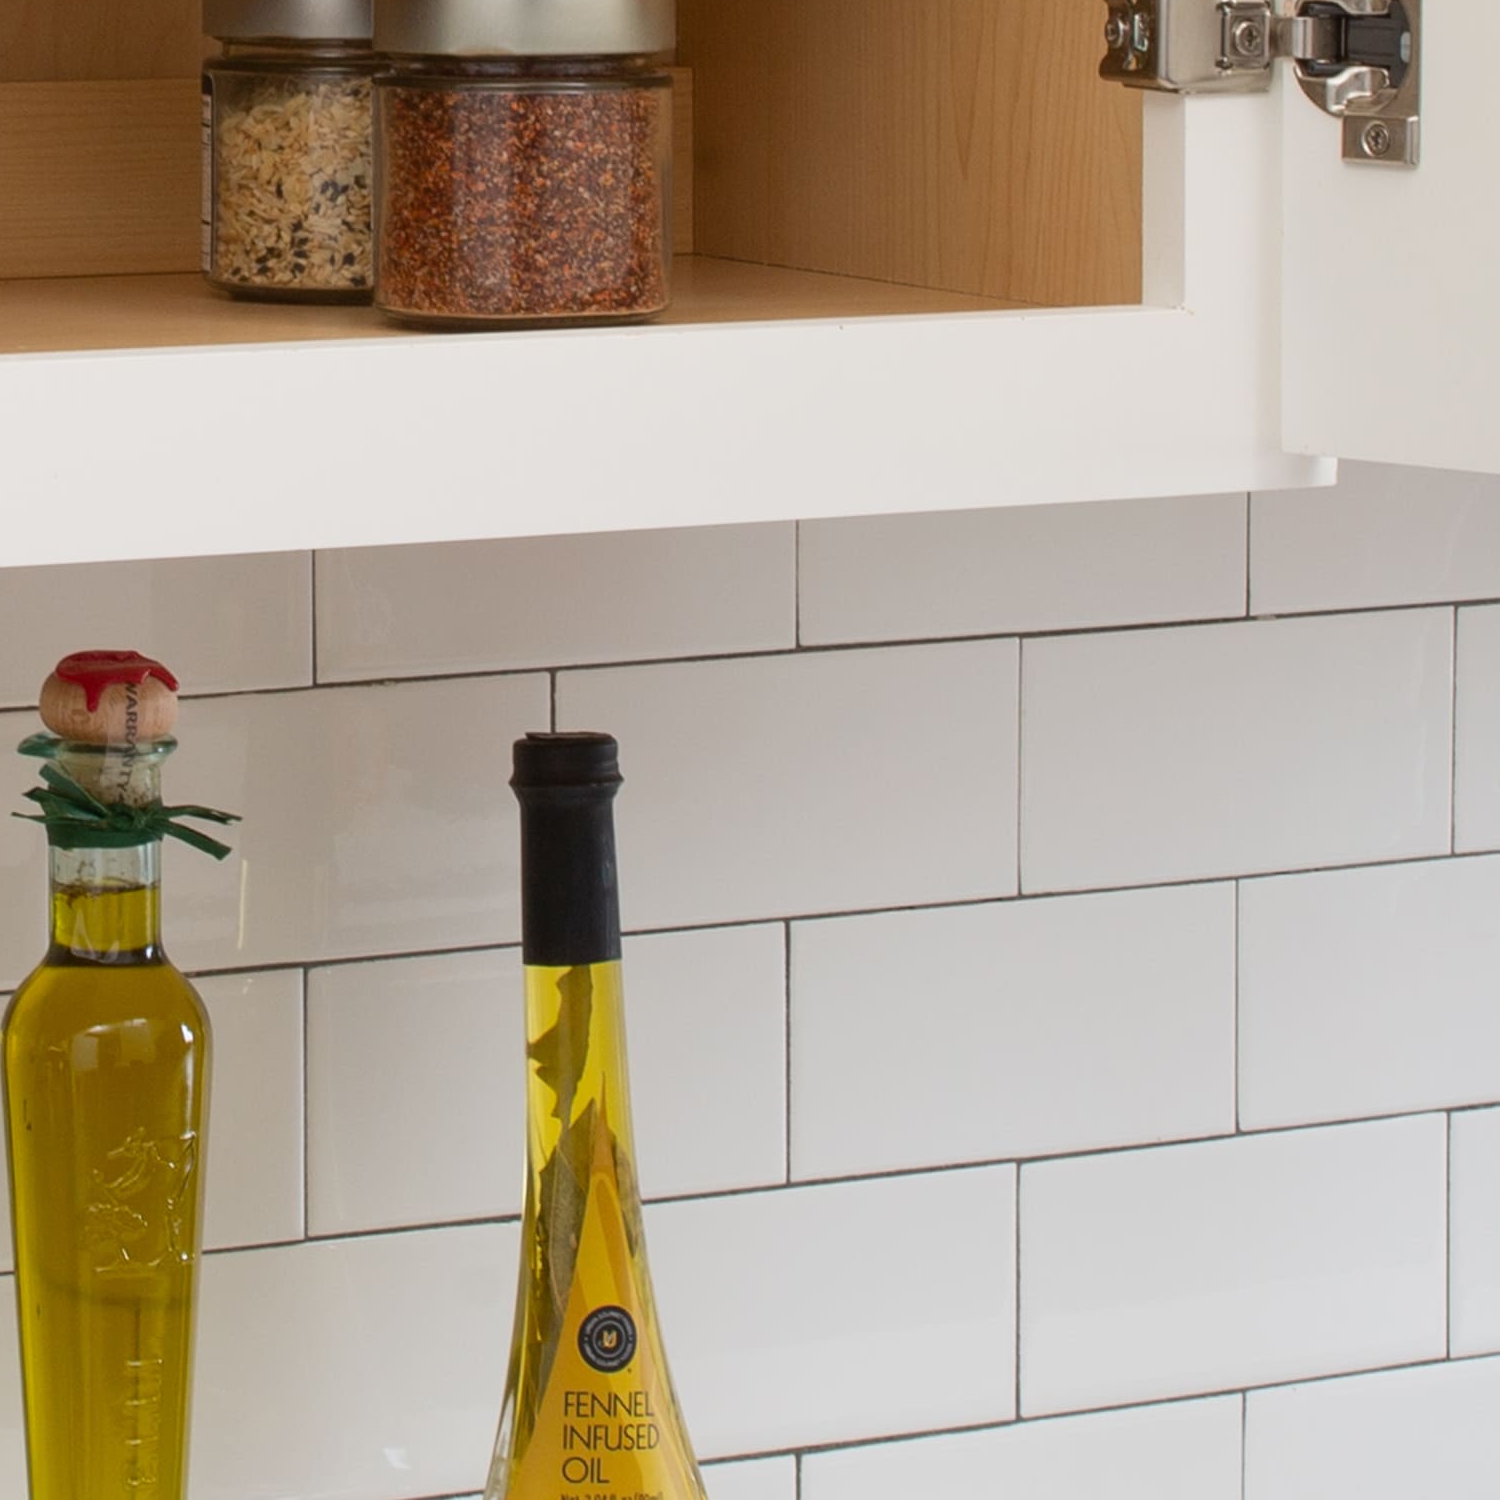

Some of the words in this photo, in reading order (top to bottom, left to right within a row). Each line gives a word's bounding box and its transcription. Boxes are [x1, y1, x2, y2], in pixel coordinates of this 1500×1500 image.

[563, 1390, 655, 1419] FENNEL
[562, 1422, 660, 1452] INFUSED
[561, 1456, 611, 1485] OIL
